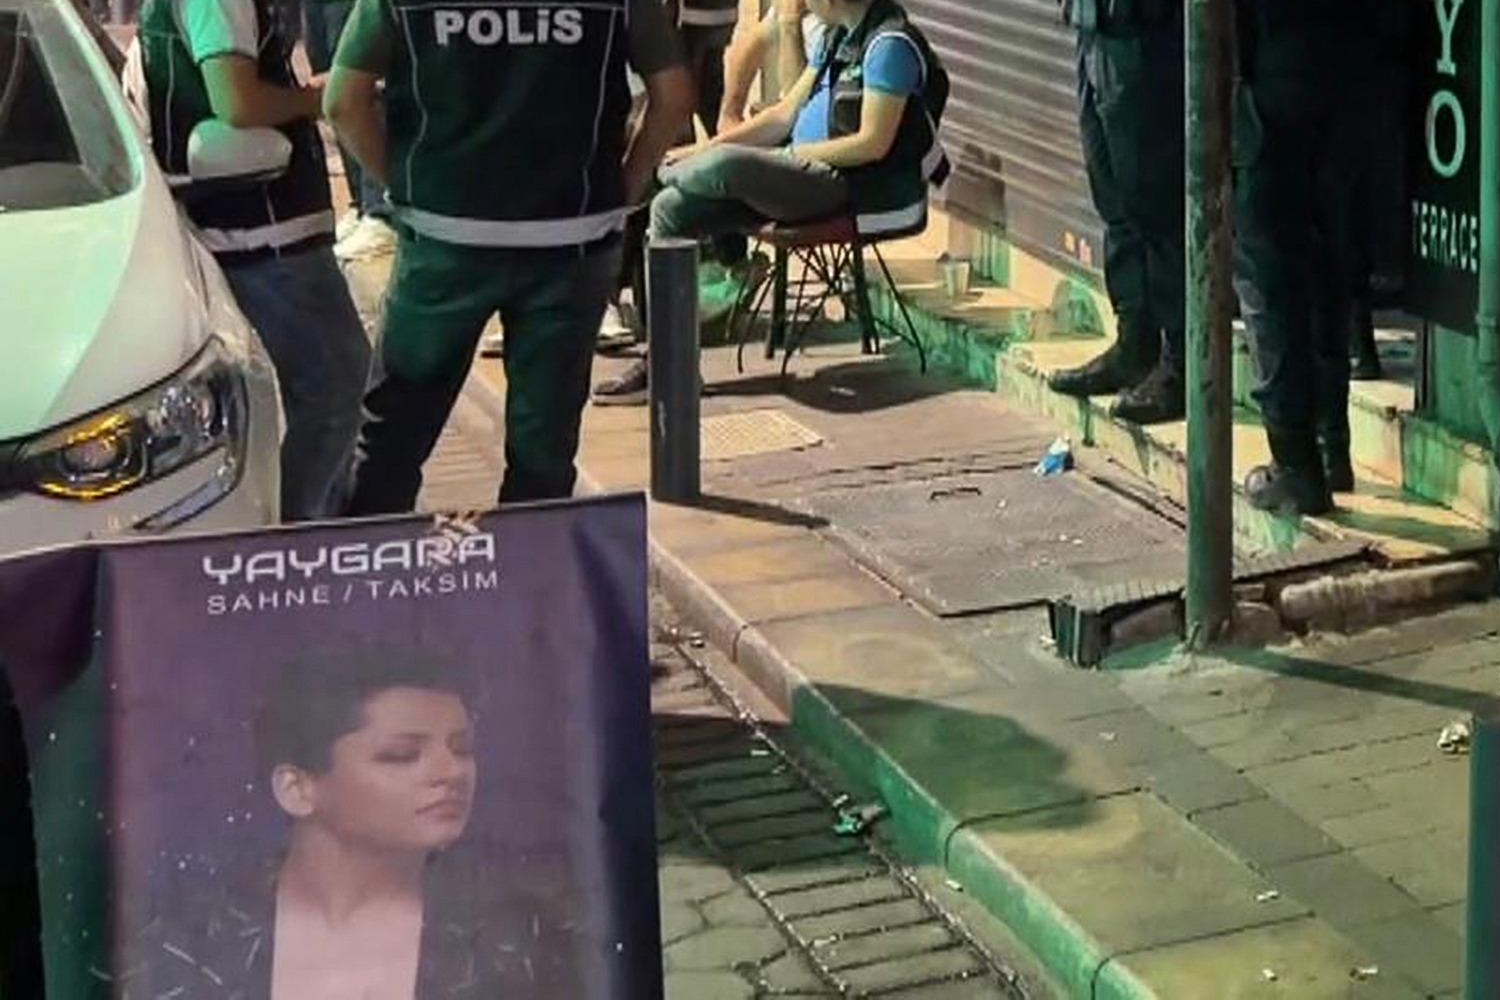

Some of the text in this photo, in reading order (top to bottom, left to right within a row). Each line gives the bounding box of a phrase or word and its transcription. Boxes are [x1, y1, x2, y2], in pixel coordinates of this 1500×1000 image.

[1411, 200, 1478, 274] TERRACE
[203, 533, 496, 585] YAYGARA
[207, 584, 330, 615] SAHNE
